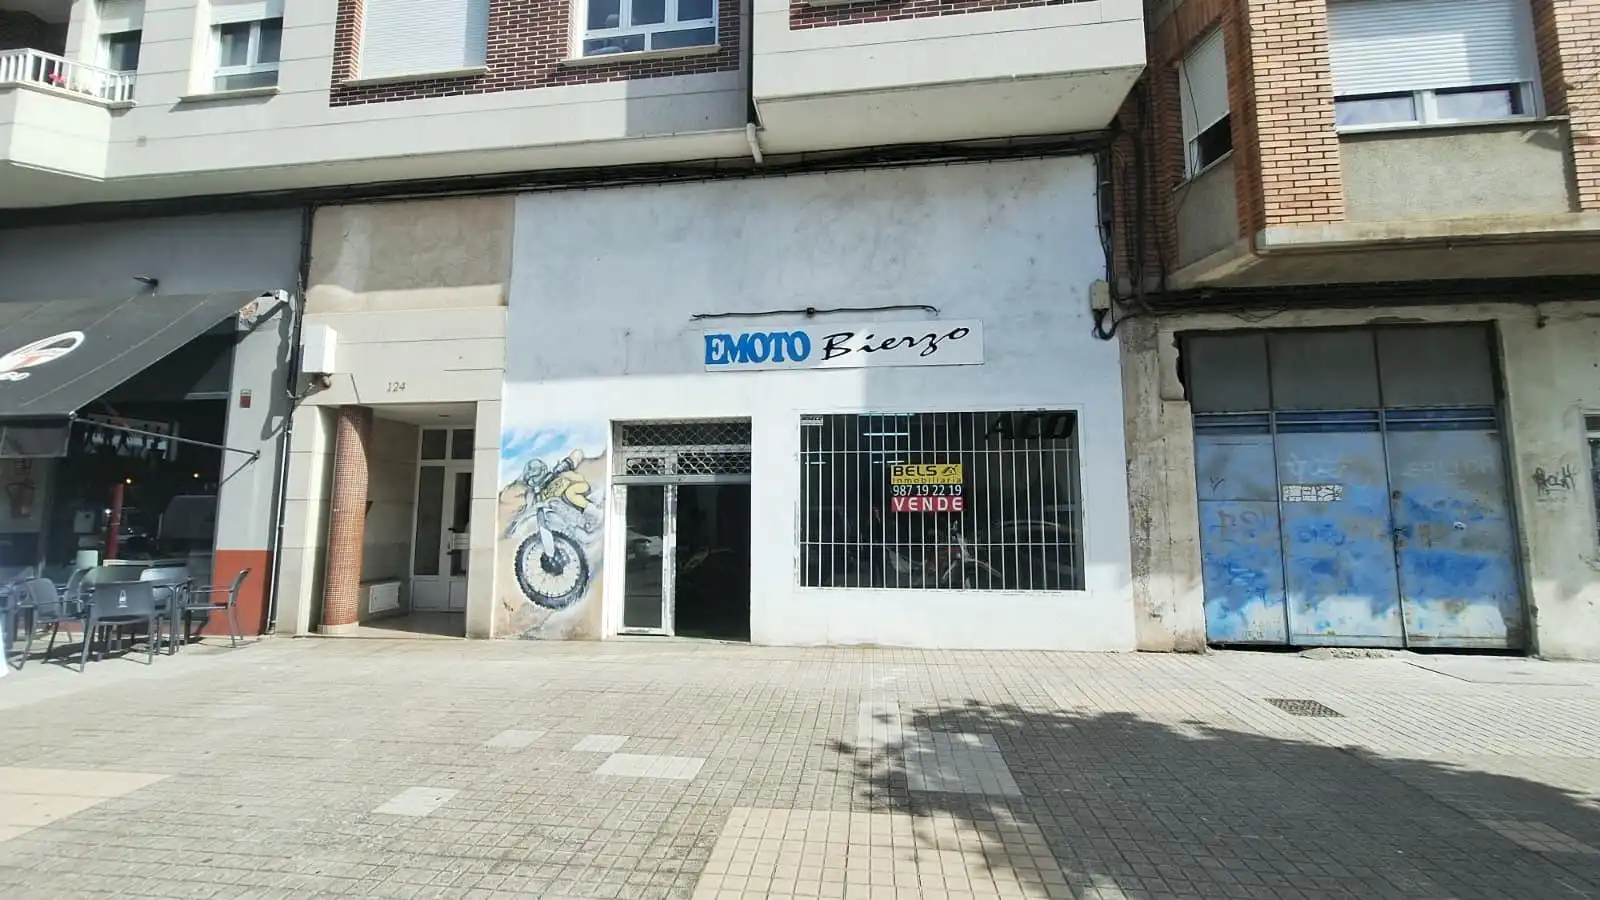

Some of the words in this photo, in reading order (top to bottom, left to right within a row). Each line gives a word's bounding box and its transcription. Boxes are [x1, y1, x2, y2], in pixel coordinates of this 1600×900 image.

[704, 331, 811, 364] EMOTO
[820, 327, 970, 360] Bierzo
[386, 381, 406, 392] 124
[892, 485, 912, 496] 987
[916, 485, 929, 496] 19
[932, 485, 945, 496] 22
[948, 485, 962, 496] 19
[893, 497, 962, 511] VENDE
